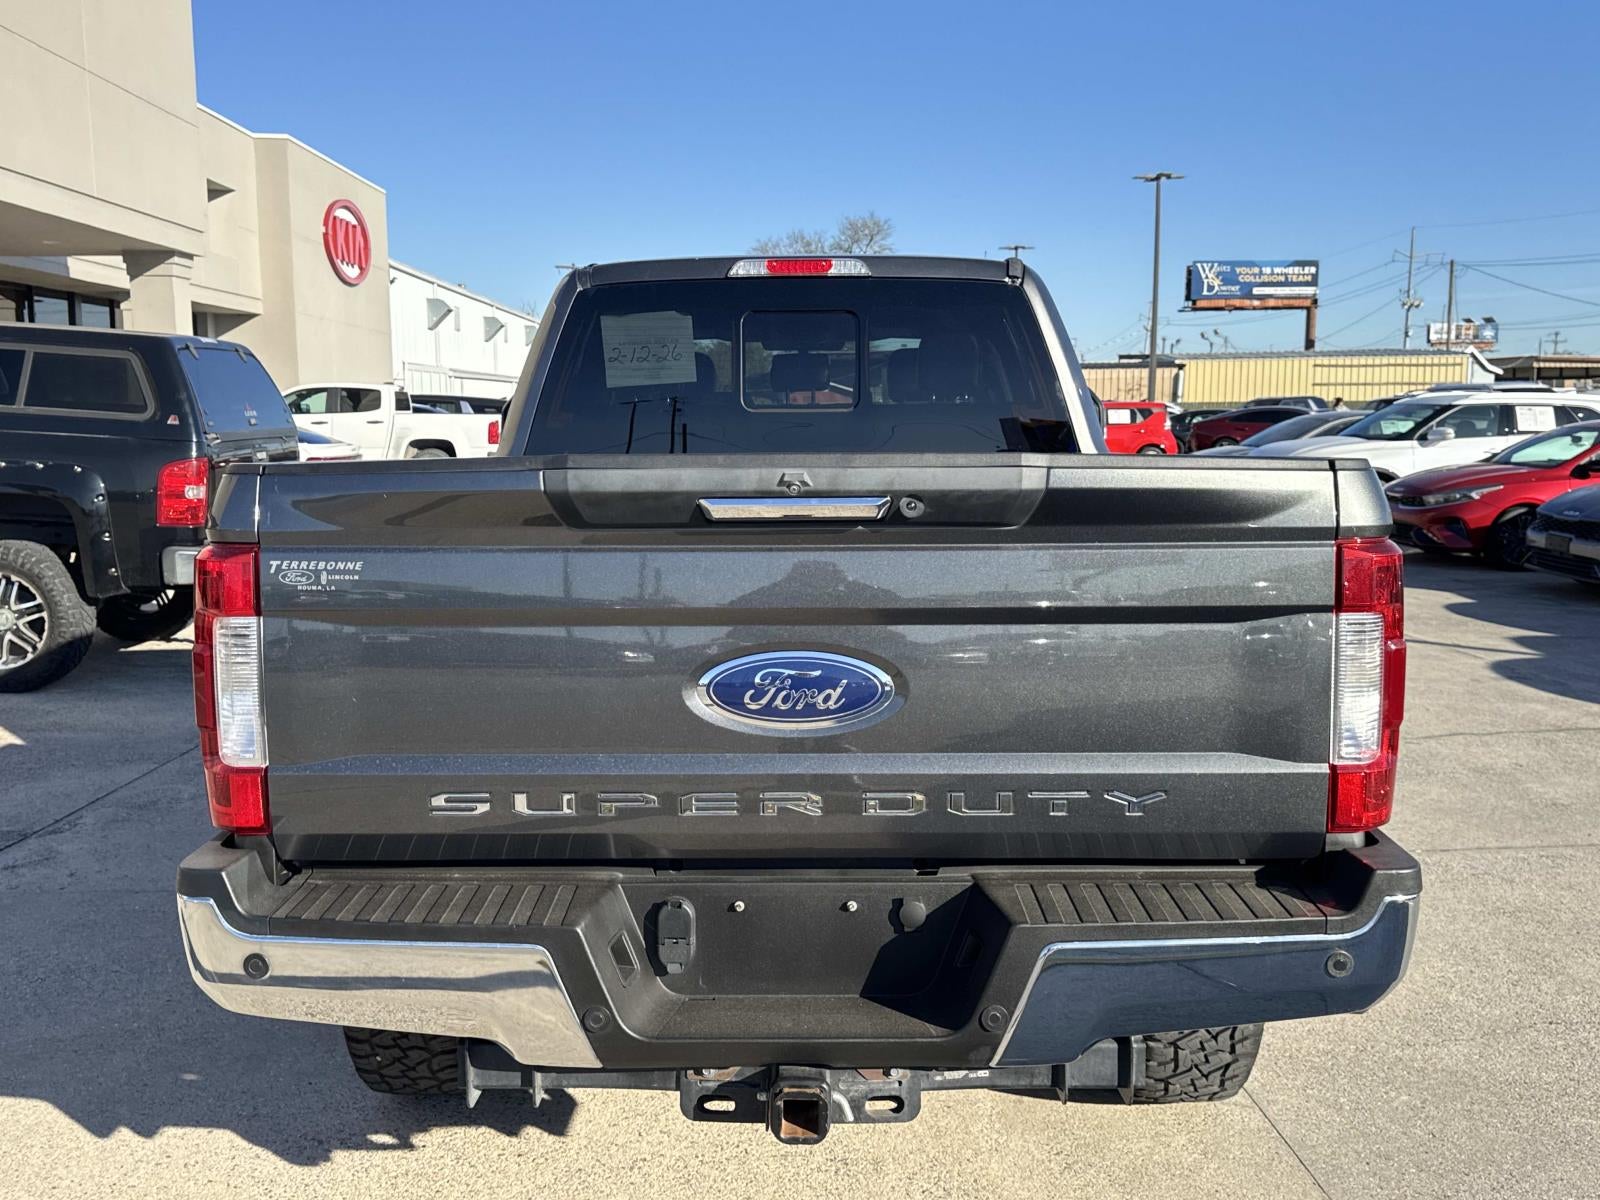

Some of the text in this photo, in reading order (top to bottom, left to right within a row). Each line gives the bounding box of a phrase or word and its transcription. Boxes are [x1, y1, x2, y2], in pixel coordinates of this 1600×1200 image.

[1235, 266, 1317, 275] YOUR 18 WHEELER
[1238, 273, 1312, 282] COLLISION TEAM
[608, 344, 683, 364] 2-12-26
[269, 560, 364, 574] TERREBONNE
[743, 668, 848, 710] Ford
[430, 791, 1167, 816] SUPER DUTY
